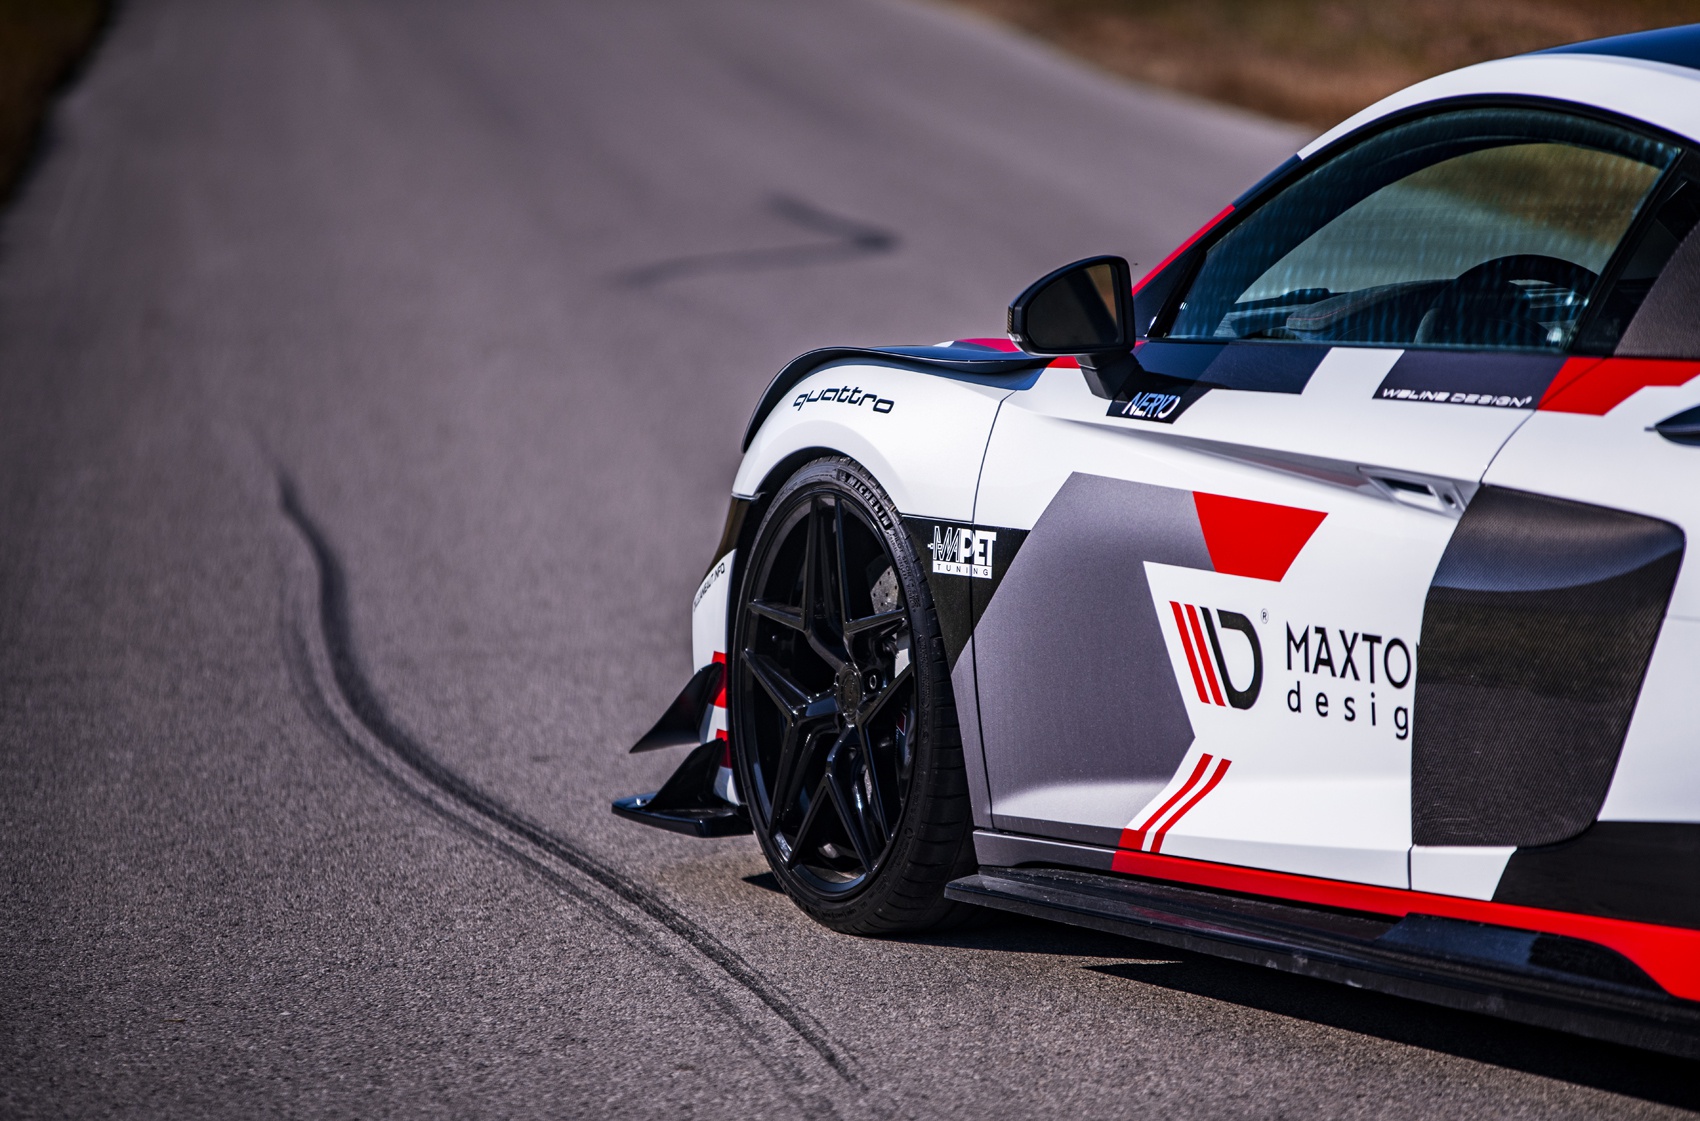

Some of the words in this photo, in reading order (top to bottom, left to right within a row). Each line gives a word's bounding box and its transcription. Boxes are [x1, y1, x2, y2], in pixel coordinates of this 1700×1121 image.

[793, 385, 895, 414] quattro
[847, 475, 891, 526] MICHELIN
[937, 563, 989, 576] TUNING
[1286, 620, 1418, 690] MAXTO
[1286, 680, 1410, 741] desig
